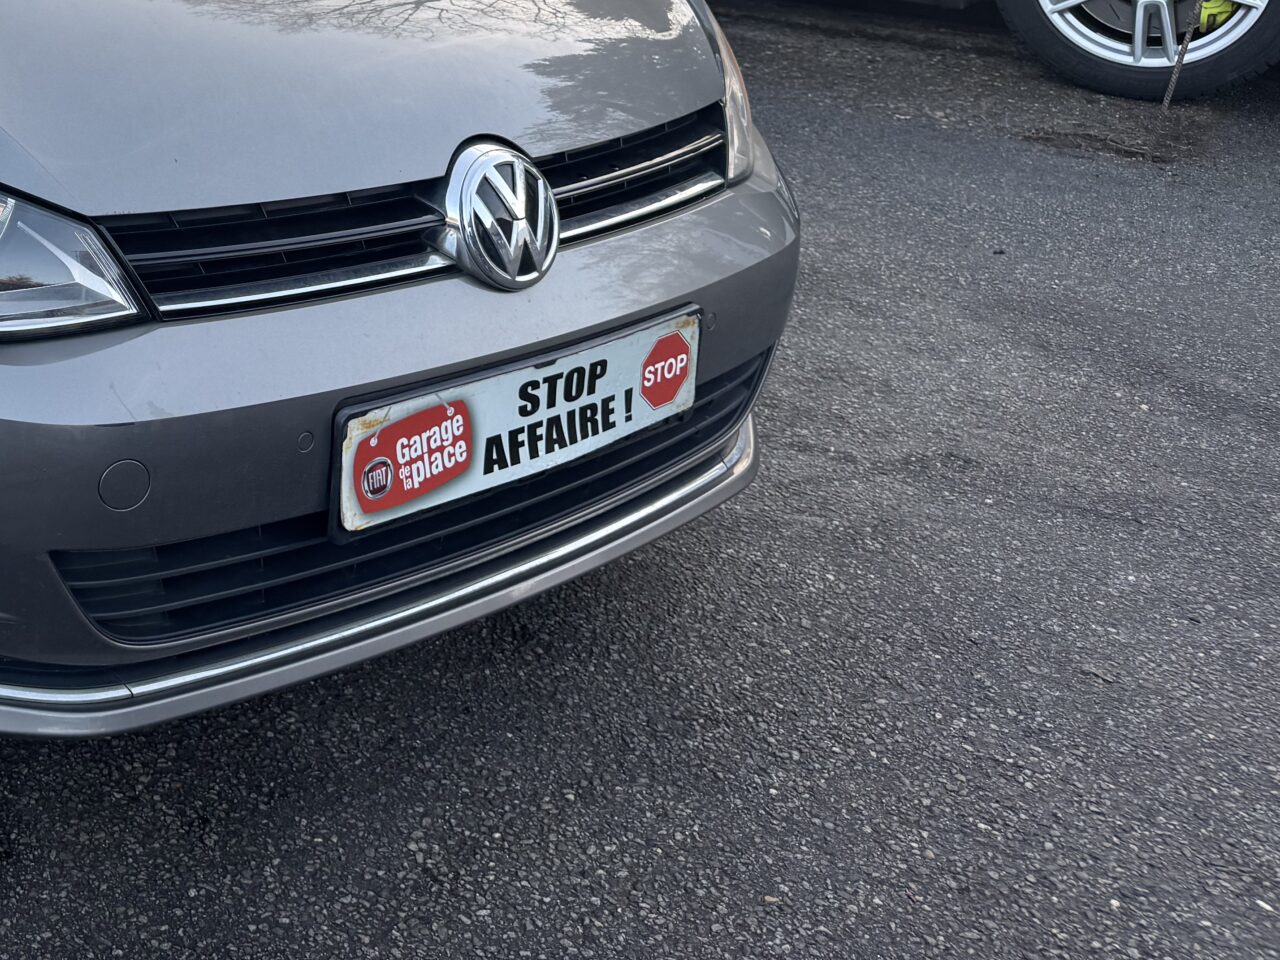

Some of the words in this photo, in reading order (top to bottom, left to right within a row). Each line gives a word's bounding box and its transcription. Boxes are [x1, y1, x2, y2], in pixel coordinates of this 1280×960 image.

[518, 359, 608, 417] STOP
[643, 353, 688, 388] STOP
[396, 414, 464, 464] Garage
[483, 394, 616, 475] AFFAIRE
[624, 387, 633, 423] !
[368, 466, 387, 490] FIAT
[399, 465, 411, 479] de
[403, 477, 413, 490] la
[411, 440, 467, 489] place
